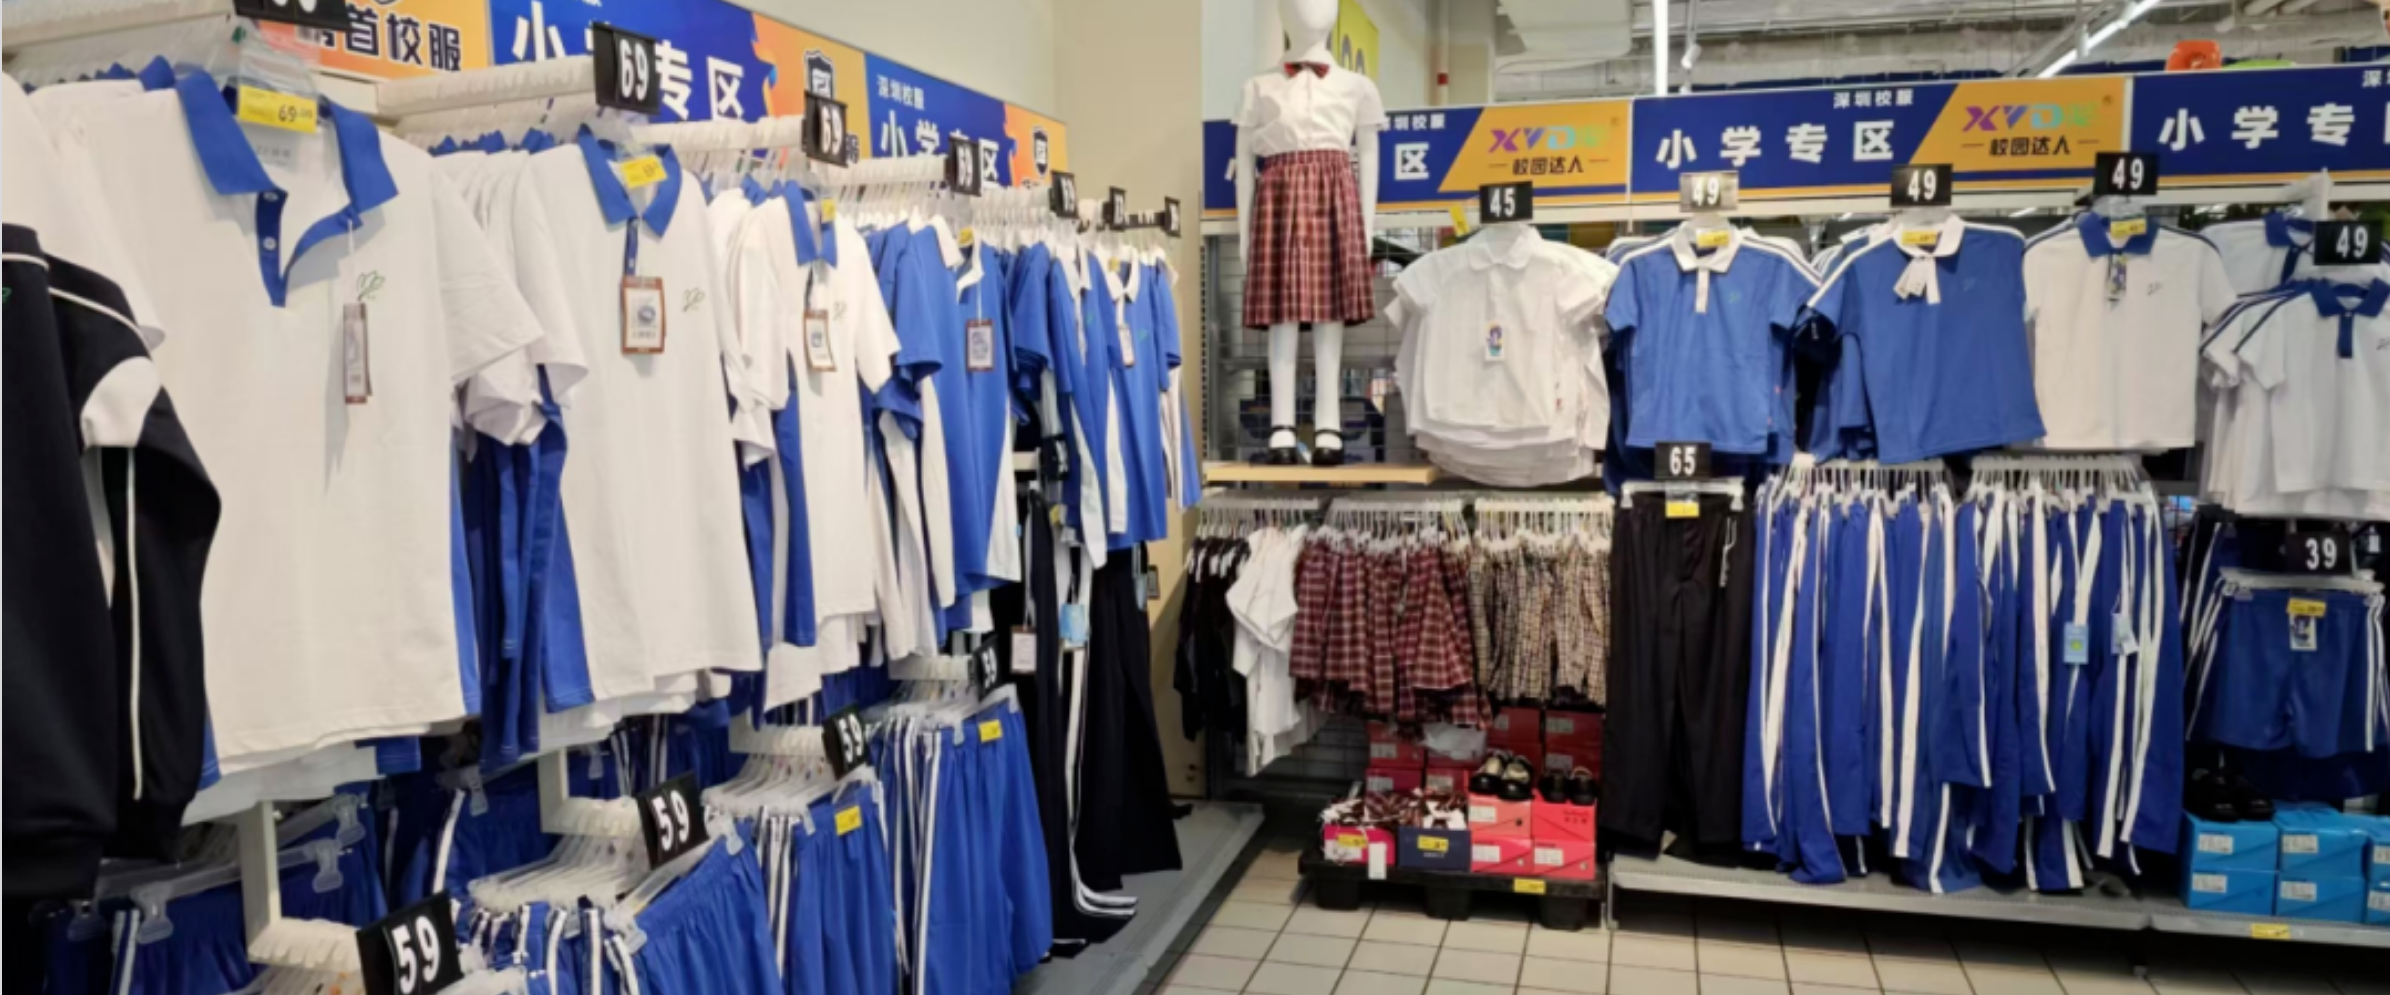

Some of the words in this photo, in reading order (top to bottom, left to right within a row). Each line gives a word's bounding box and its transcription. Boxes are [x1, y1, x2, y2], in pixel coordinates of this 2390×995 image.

[511, 0, 745, 122] 小专区
[619, 38, 649, 101] 69
[1833, 88, 1913, 109] 深圳校服
[820, 104, 843, 156] 69
[1656, 120, 1894, 169] 小学专区
[2157, 102, 2390, 151] 小学专
[880, 109, 1000, 188] 小学区
[1989, 135, 2071, 157] 校园达人
[1512, 156, 1584, 176] 校园达人
[2112, 157, 2145, 190] 49
[1489, 186, 1516, 218] 45
[1692, 176, 1720, 206] 49
[1907, 170, 1936, 202] 49
[2335, 226, 2368, 259] 49
[1669, 446, 1697, 477] 65
[2304, 537, 2338, 570] 39
[981, 647, 998, 689] 59
[838, 713, 864, 763] 59
[652, 790, 690, 850] 59
[391, 915, 440, 995] 59
